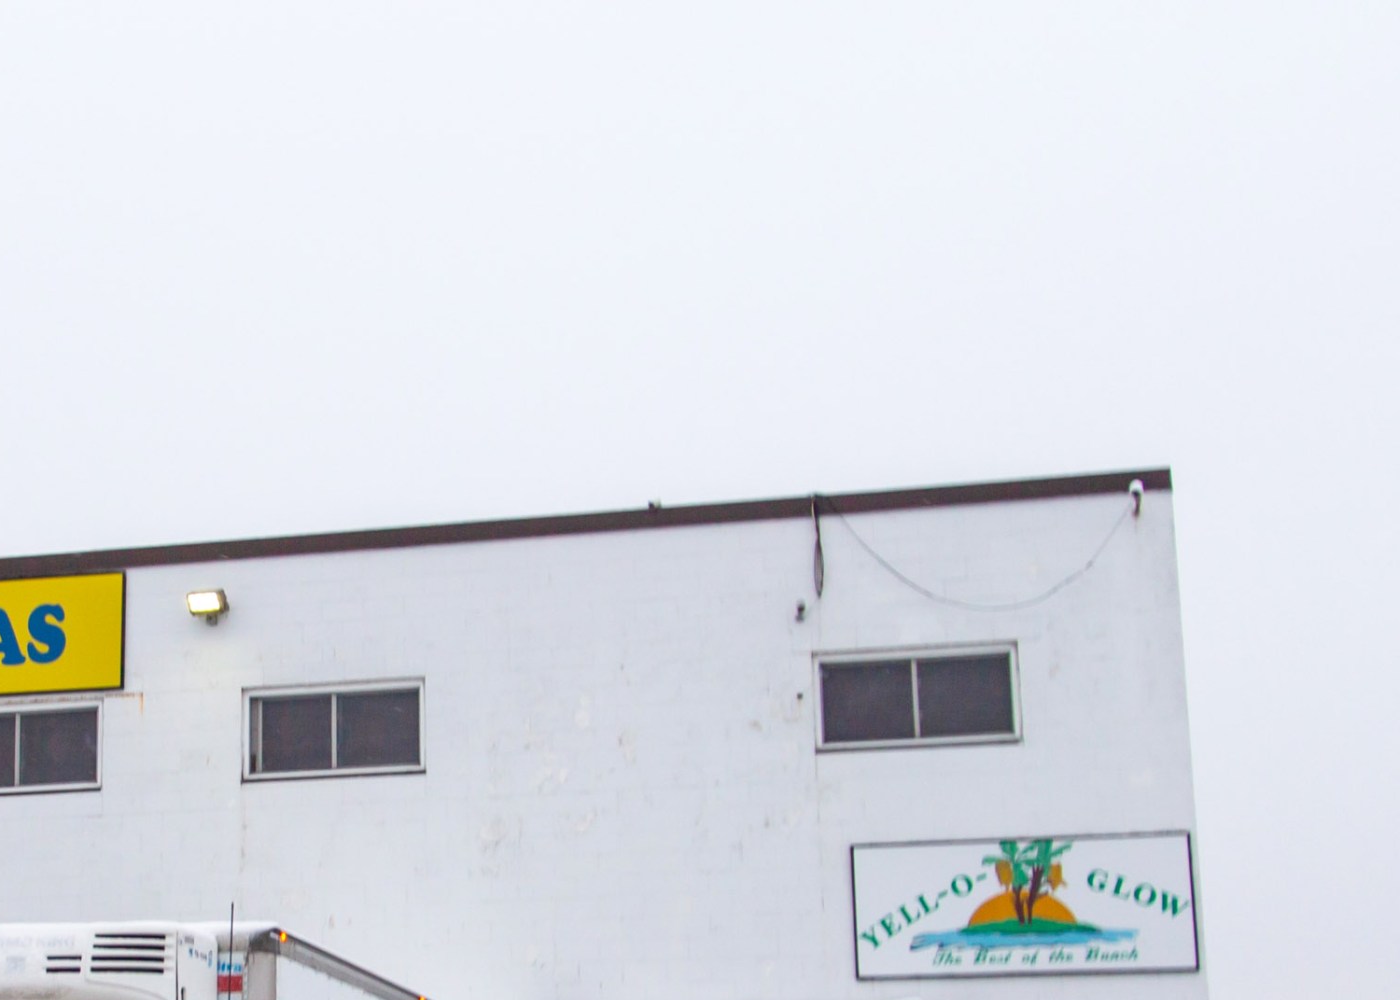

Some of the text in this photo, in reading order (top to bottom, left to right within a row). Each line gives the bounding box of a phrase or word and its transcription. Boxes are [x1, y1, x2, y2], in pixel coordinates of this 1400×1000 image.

[1085, 867, 1190, 919] GLOW
[932, 945, 1139, 967] The Best of the Bunch
